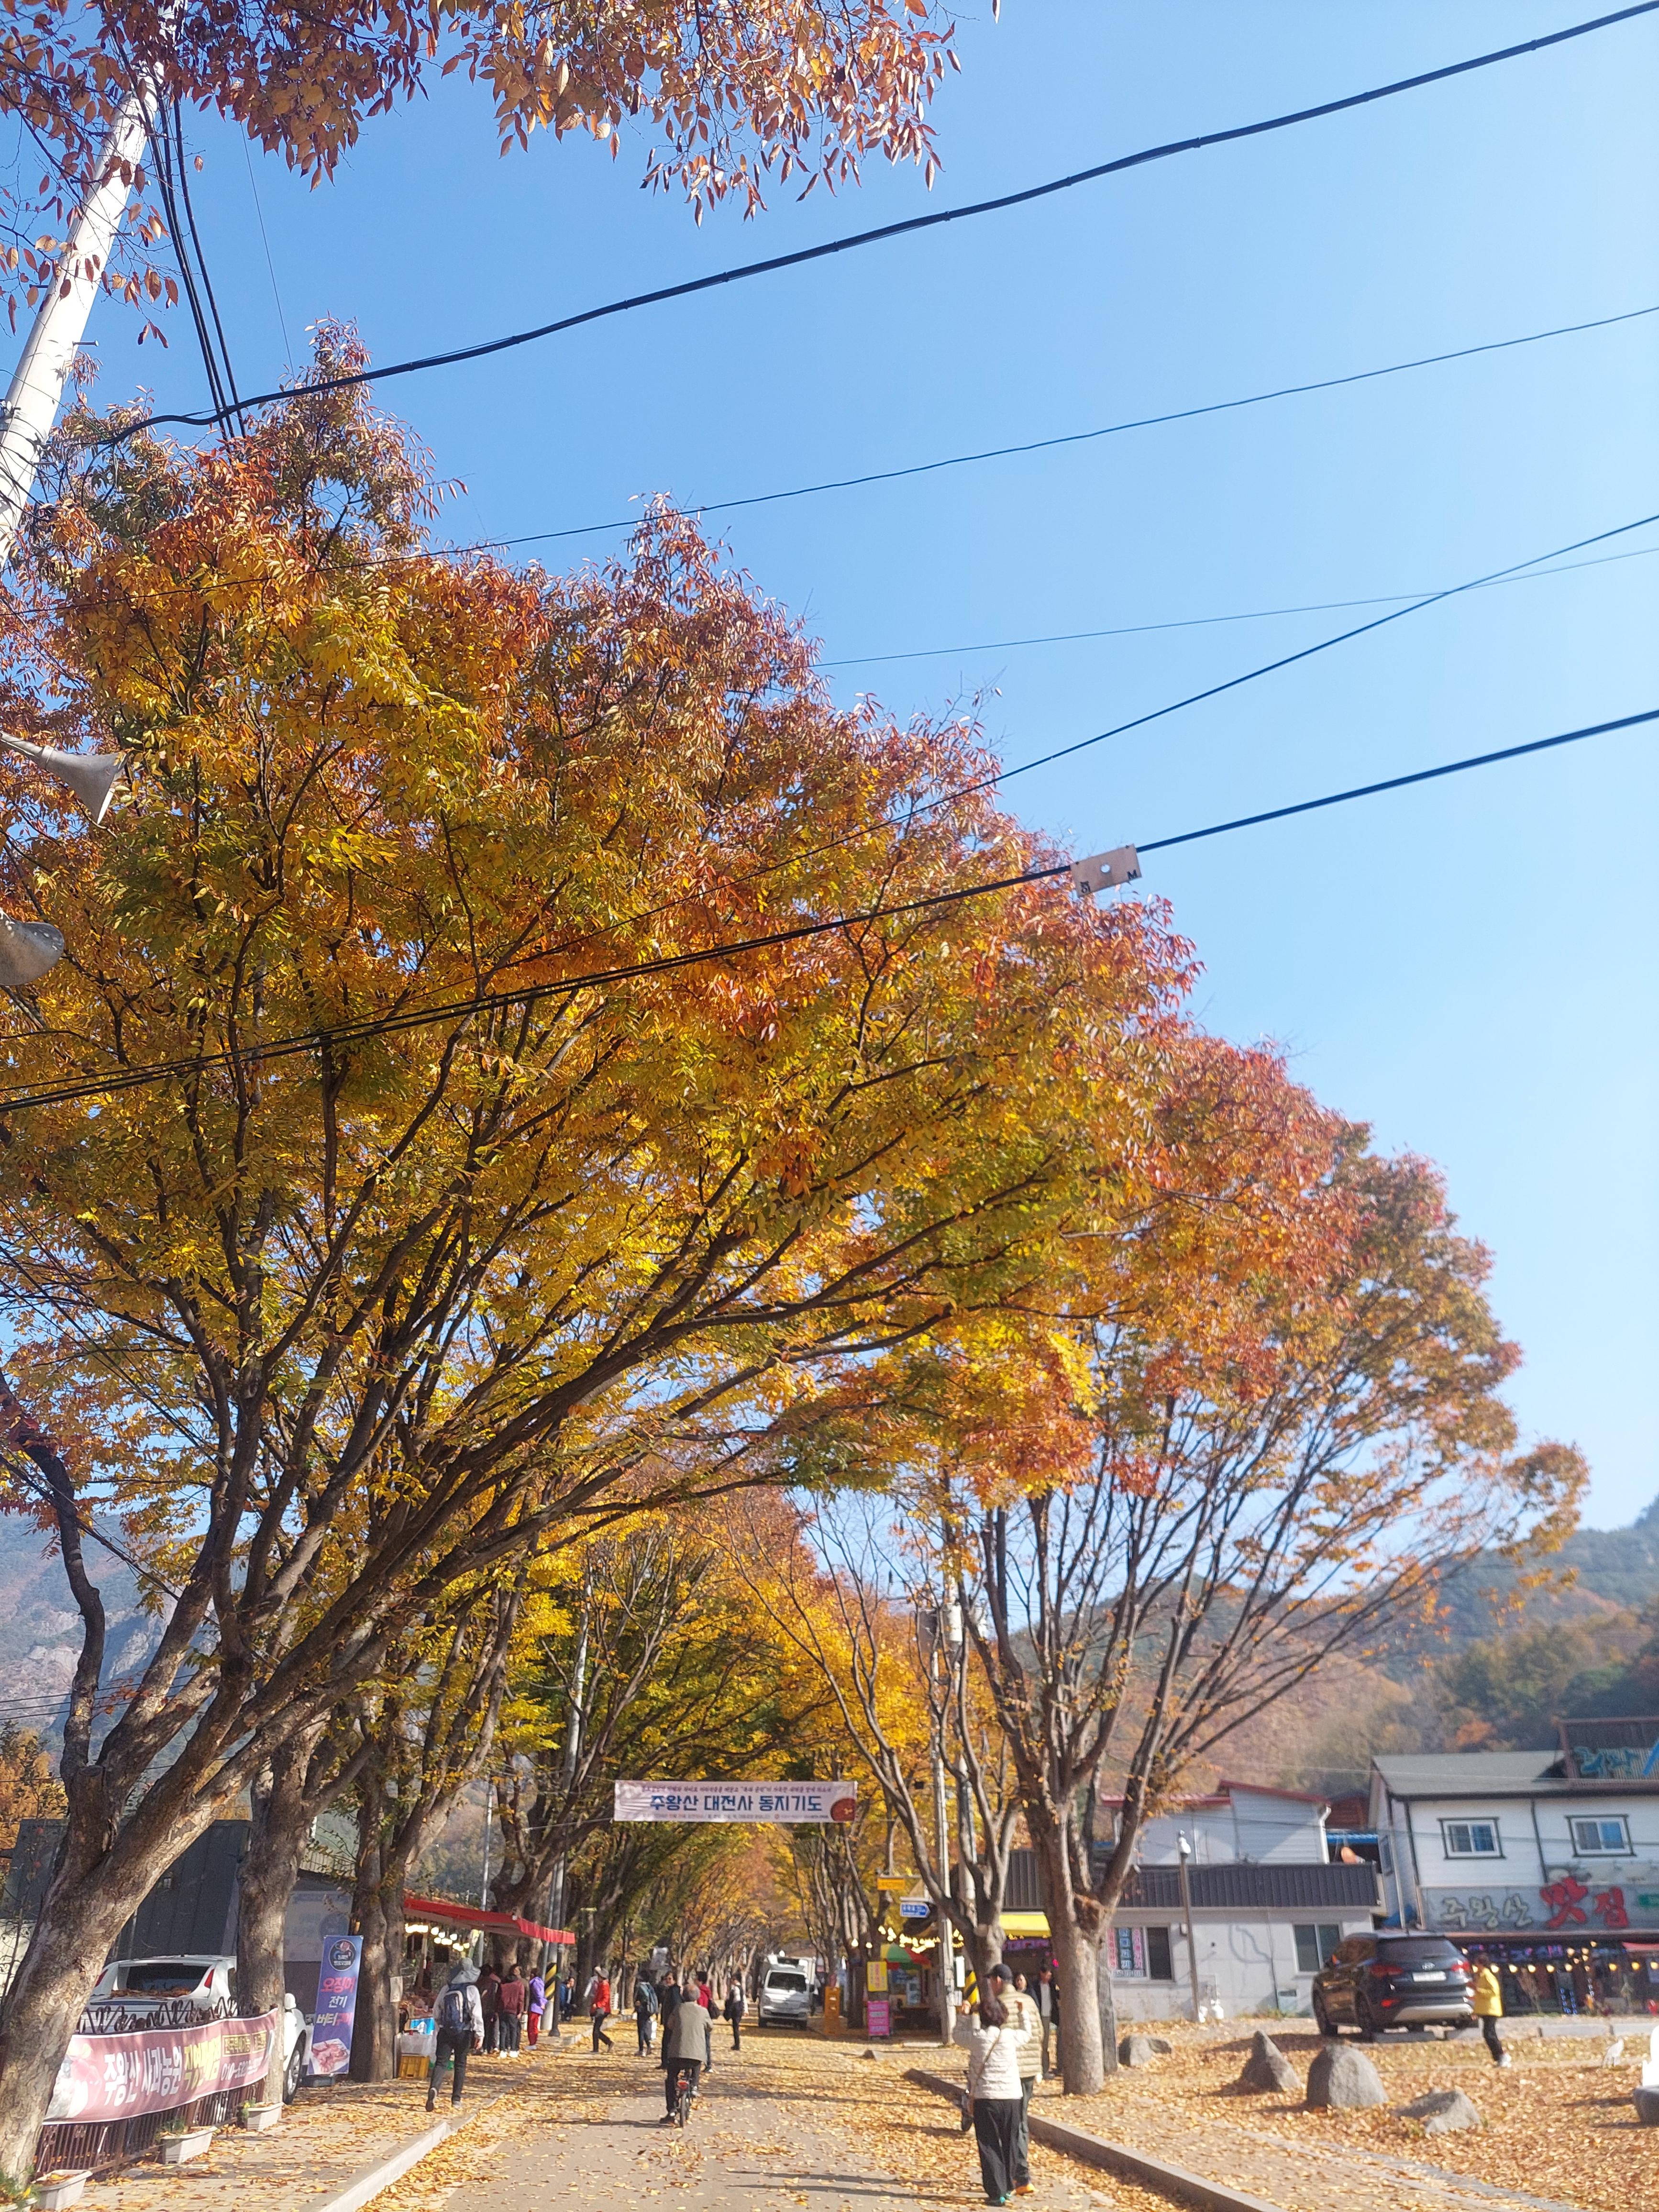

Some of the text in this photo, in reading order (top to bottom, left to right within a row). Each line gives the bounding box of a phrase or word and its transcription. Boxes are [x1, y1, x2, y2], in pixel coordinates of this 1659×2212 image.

[650, 1795, 822, 1811] 주왕산 대전사 동지기도
[1440, 1876, 1629, 1930] 주왕산 맛집
[321, 1977, 355, 1994] 오징어
[329, 1995, 347, 2008] 전기
[103, 2050, 141, 2106] 주왕산
[141, 2046, 183, 2097] 사과농원
